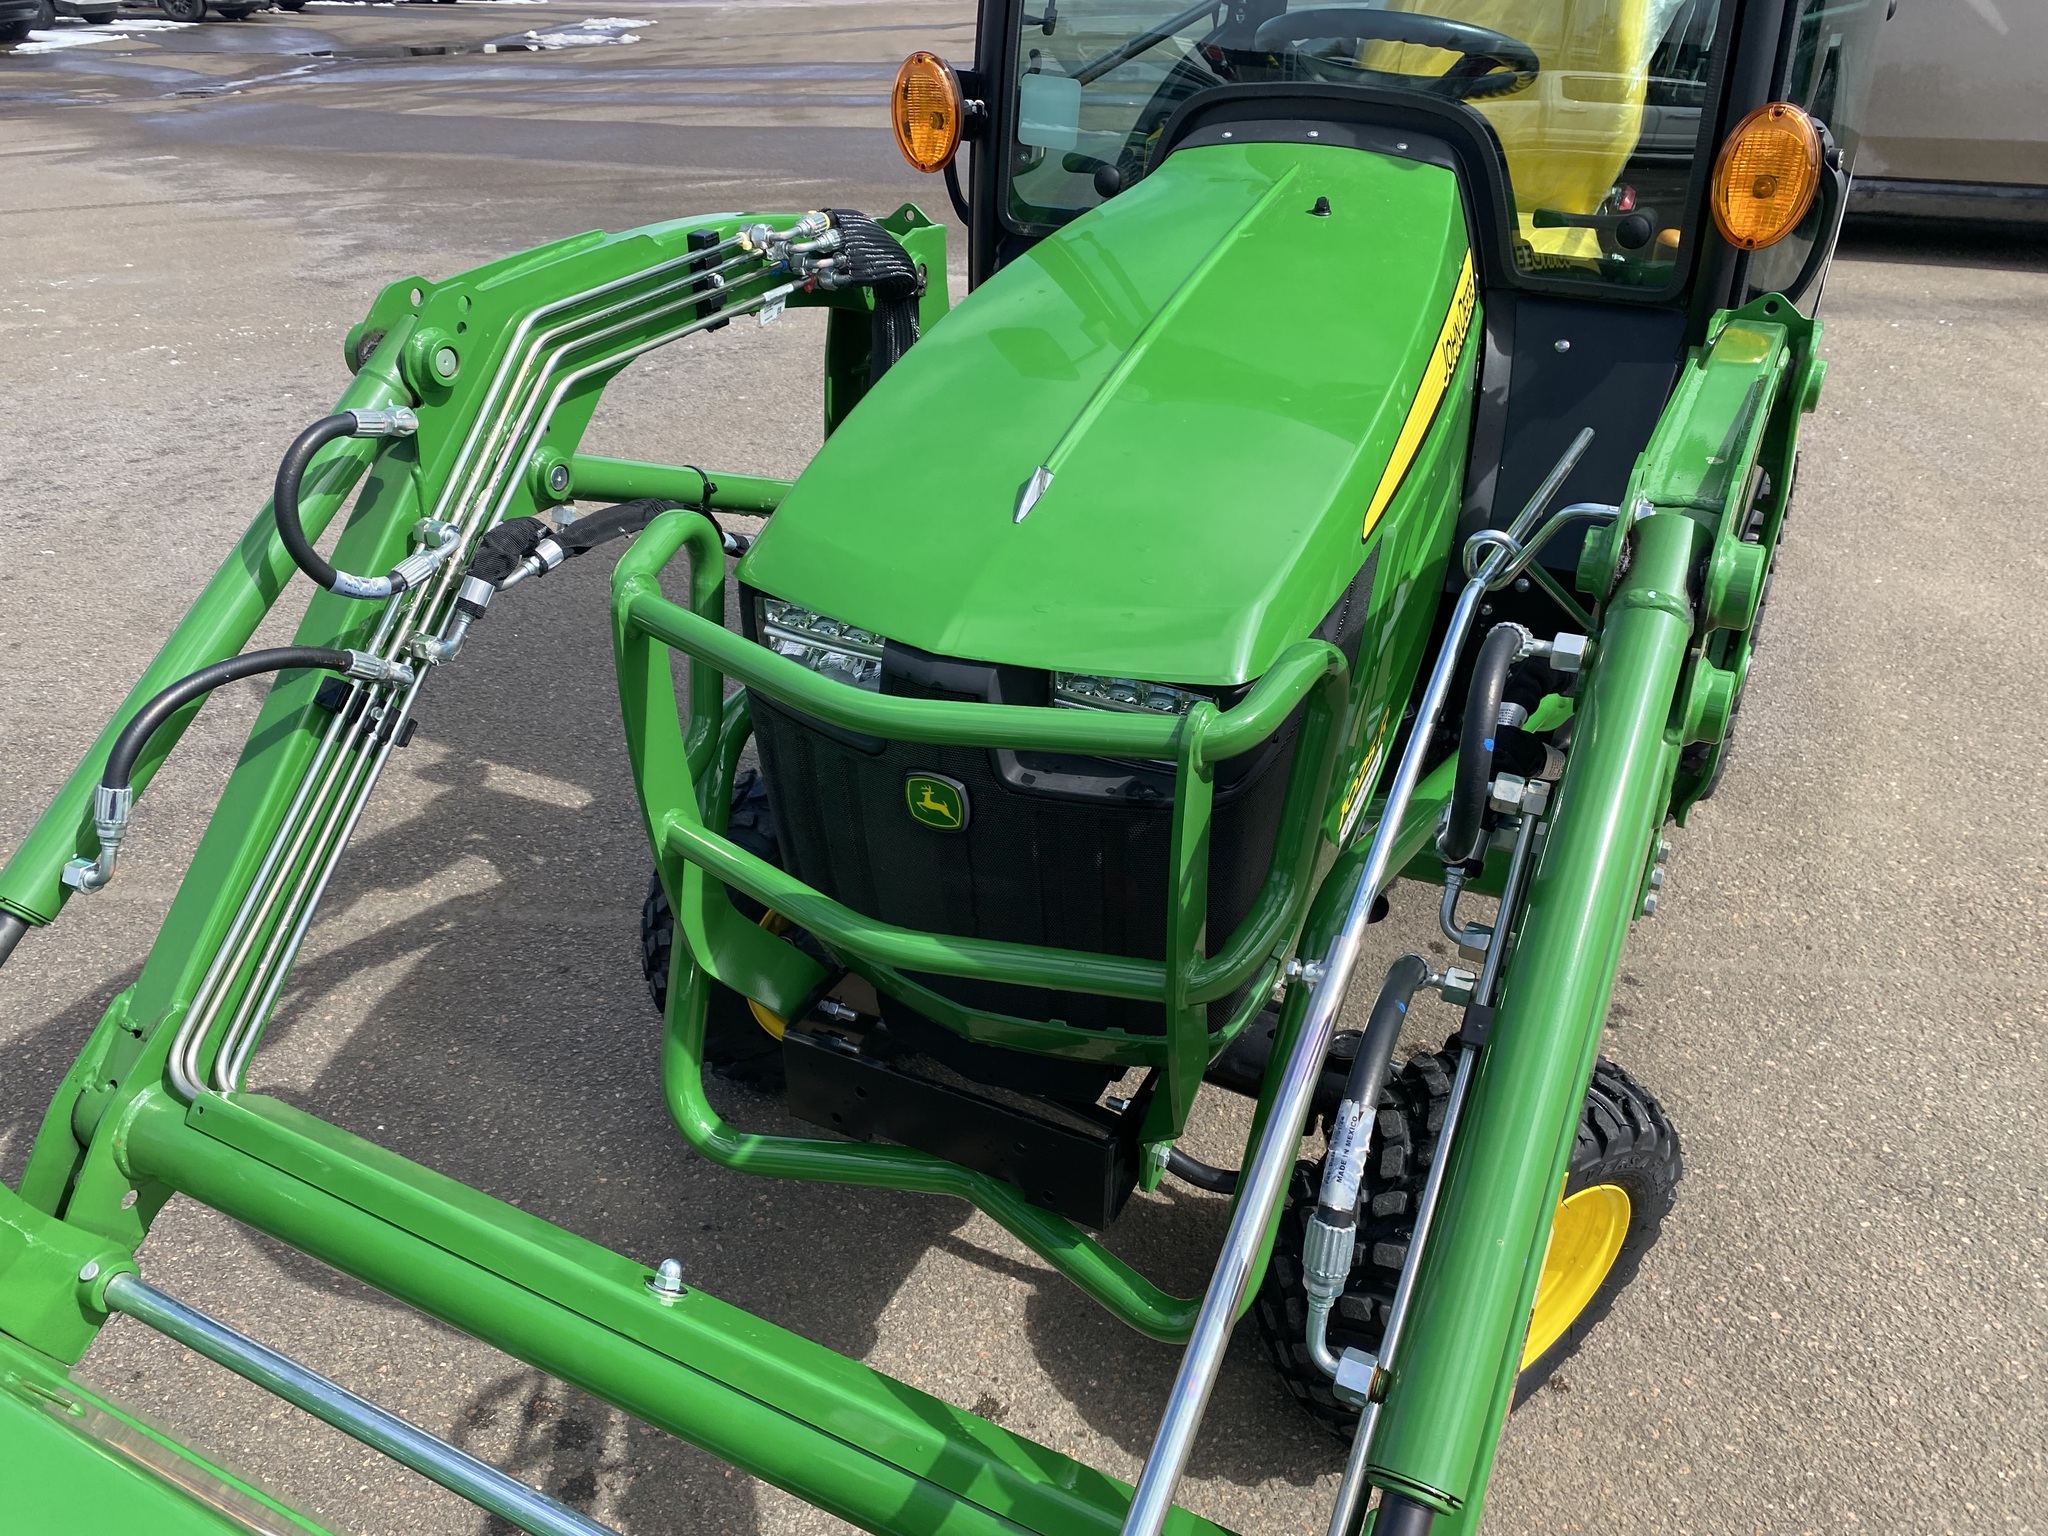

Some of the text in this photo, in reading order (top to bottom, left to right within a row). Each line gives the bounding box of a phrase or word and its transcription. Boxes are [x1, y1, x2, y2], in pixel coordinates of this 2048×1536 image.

[1442, 315, 1463, 385] JOHN
[1336, 1115, 1358, 1183] MADE IN MEXICO
